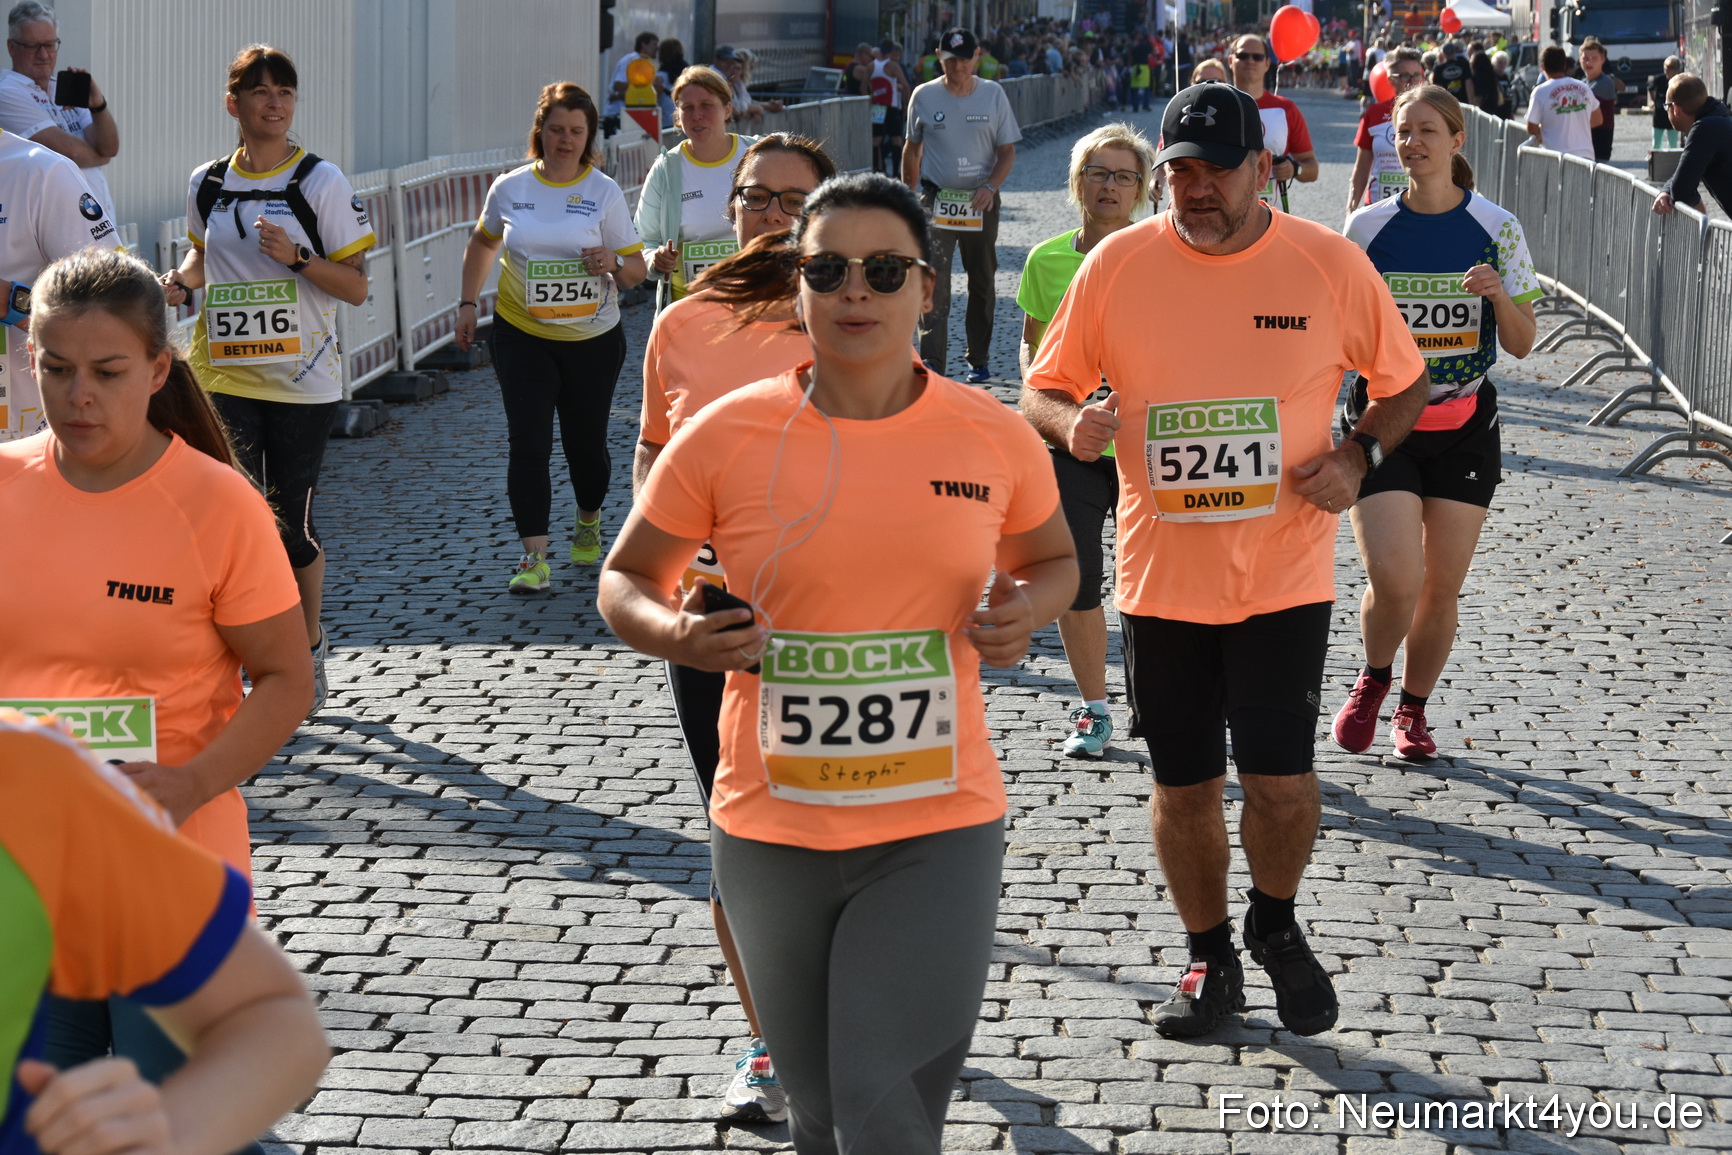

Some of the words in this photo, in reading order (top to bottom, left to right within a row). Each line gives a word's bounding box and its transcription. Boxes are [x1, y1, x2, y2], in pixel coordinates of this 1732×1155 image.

[957, 157, 970, 166] 19.
[567, 195, 581, 204] 20
[212, 282, 291, 304] BOCK
[535, 281, 593, 303] 5254
[216, 308, 290, 337] 5216
[1253, 315, 1307, 331] THULE
[224, 342, 285, 356] BETTINA
[1413, 336, 1464, 348] RINNA
[306, 345, 326, 371] September
[1156, 403, 1269, 436] BOCK
[1160, 442, 1262, 482] 5241
[1269, 443, 1276, 451] S
[929, 480, 990, 503] THULE
[1184, 491, 1245, 509] DAVID
[106, 580, 175, 605] THULE
[773, 635, 937, 679] BOCK
[780, 689, 931, 745] 5287
[938, 690, 947, 701] S
[819, 761, 906, 786] Stephi
